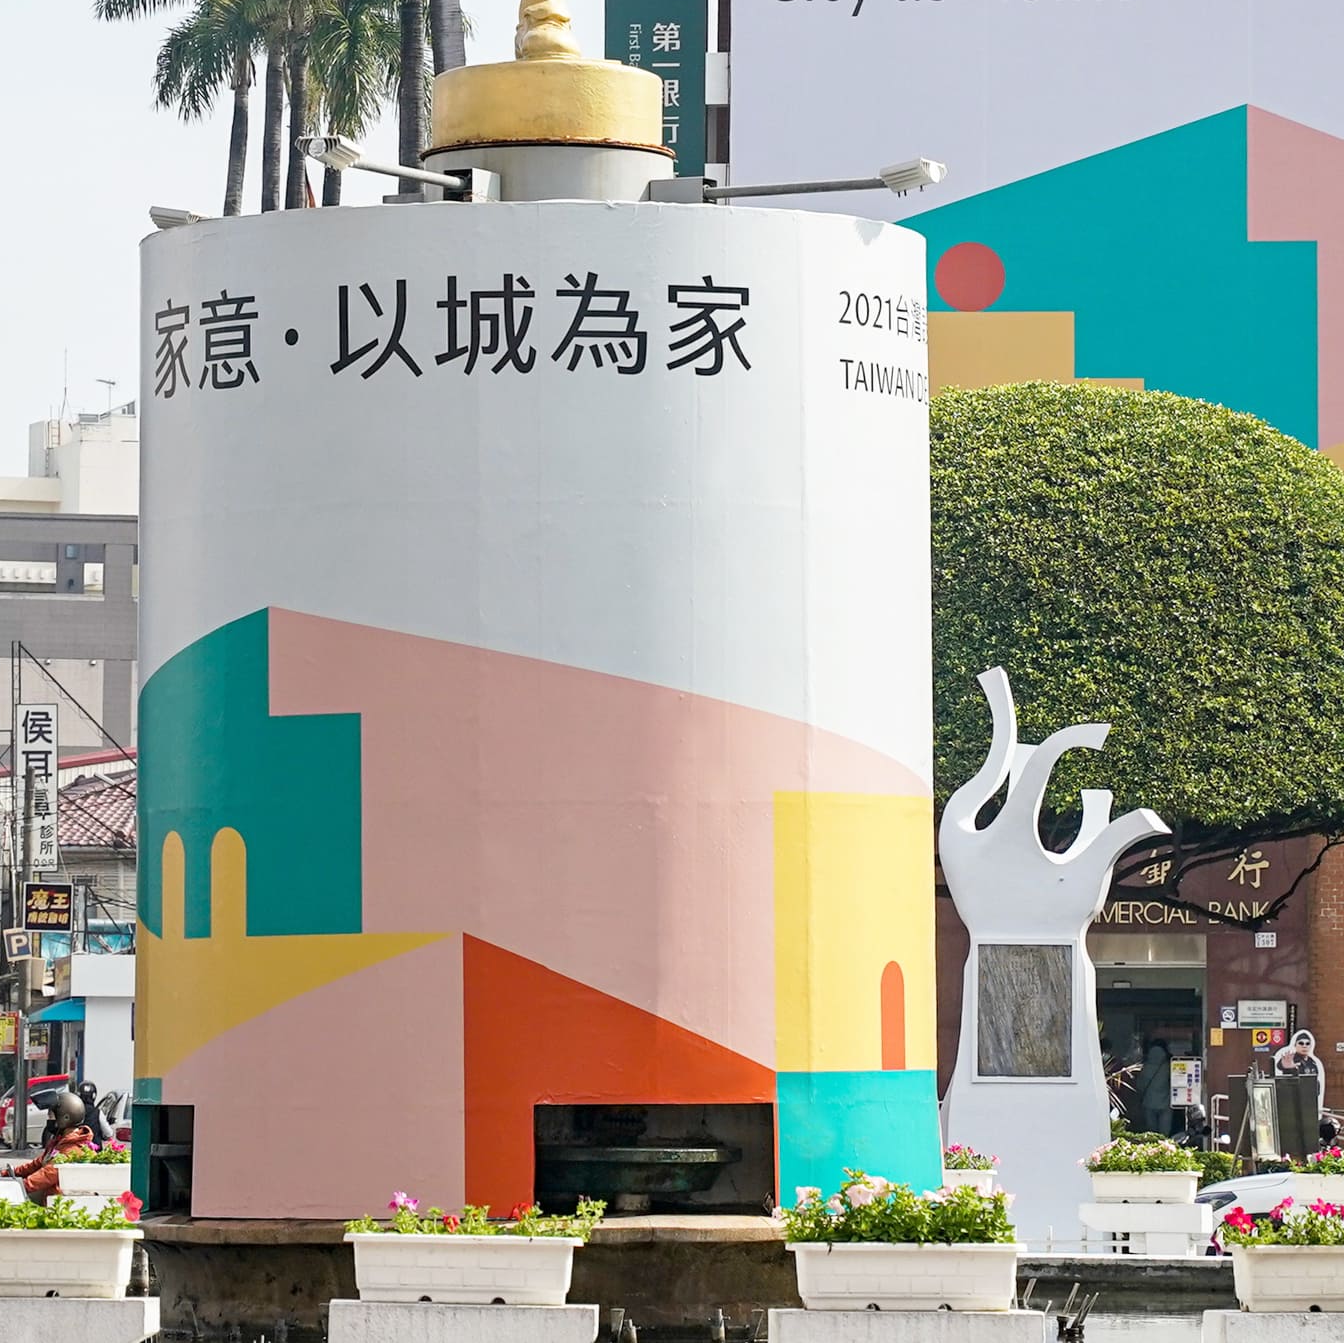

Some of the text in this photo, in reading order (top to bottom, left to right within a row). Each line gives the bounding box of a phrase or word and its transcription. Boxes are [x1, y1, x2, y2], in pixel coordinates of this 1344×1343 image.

[629, 23, 642, 50] First
[840, 358, 915, 400] TAIWAN
[11, 935, 29, 955] P
